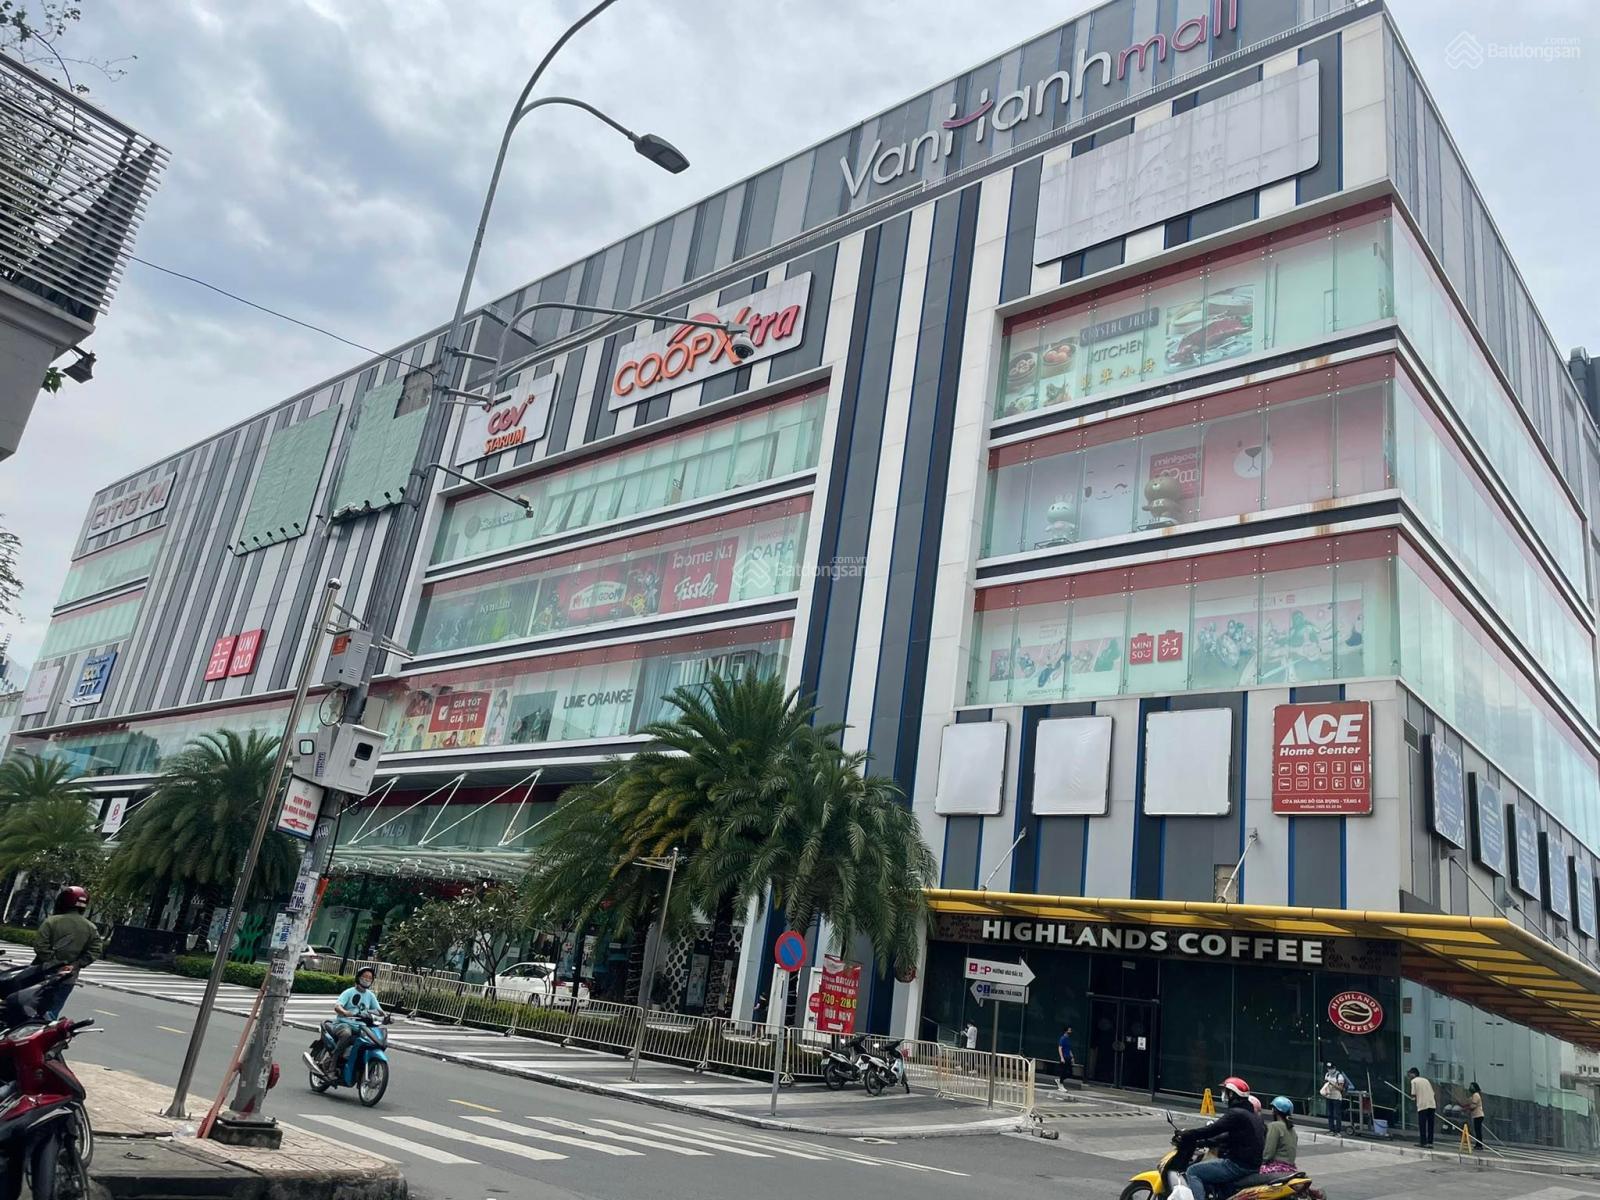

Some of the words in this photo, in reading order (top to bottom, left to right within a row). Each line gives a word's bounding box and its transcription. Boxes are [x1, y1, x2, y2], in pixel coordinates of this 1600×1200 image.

[488, 402, 528, 435] CGV
[484, 426, 526, 455] STARIUM
[239, 635, 256, 651] UNI
[1132, 641, 1151, 649] MINI
[233, 653, 251, 672] QLO
[563, 694, 587, 709] LIME
[588, 689, 633, 706] ORANGE
[1280, 711, 1363, 745] ACE
[1280, 748, 1314, 756] Home
[1318, 746, 1360, 755] Center
[982, 920, 1168, 951] HIGHLANDS
[1177, 932, 1323, 964] COFFEE
[1331, 994, 1379, 1013] HIGHLANDS
[1338, 1020, 1376, 1031] COFFEE
